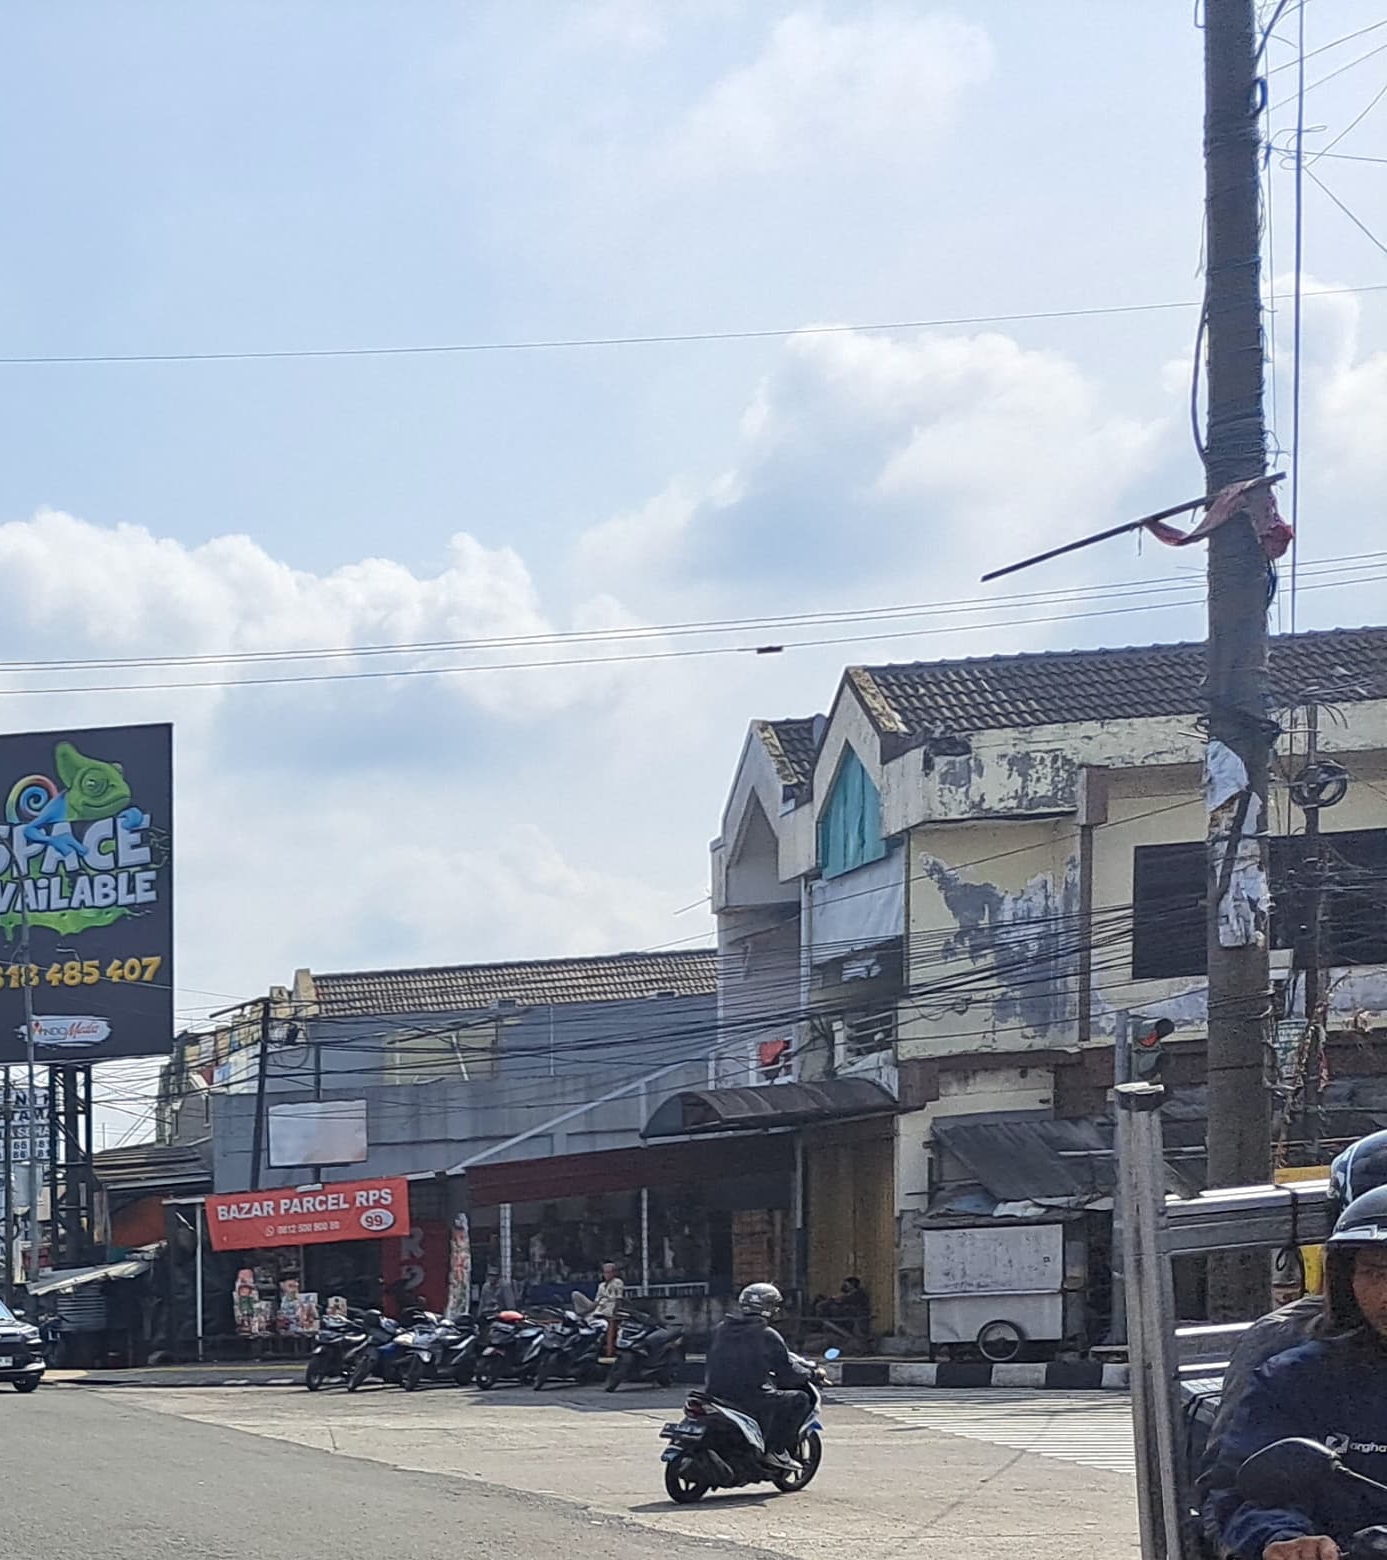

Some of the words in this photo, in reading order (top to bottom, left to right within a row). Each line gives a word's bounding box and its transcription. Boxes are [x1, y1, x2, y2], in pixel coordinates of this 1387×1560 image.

[45, 959, 101, 987] 485
[105, 956, 162, 983] 407
[216, 1201, 275, 1222] BAZAR
[279, 1193, 350, 1216] PARCEL
[354, 1188, 393, 1208] RPS
